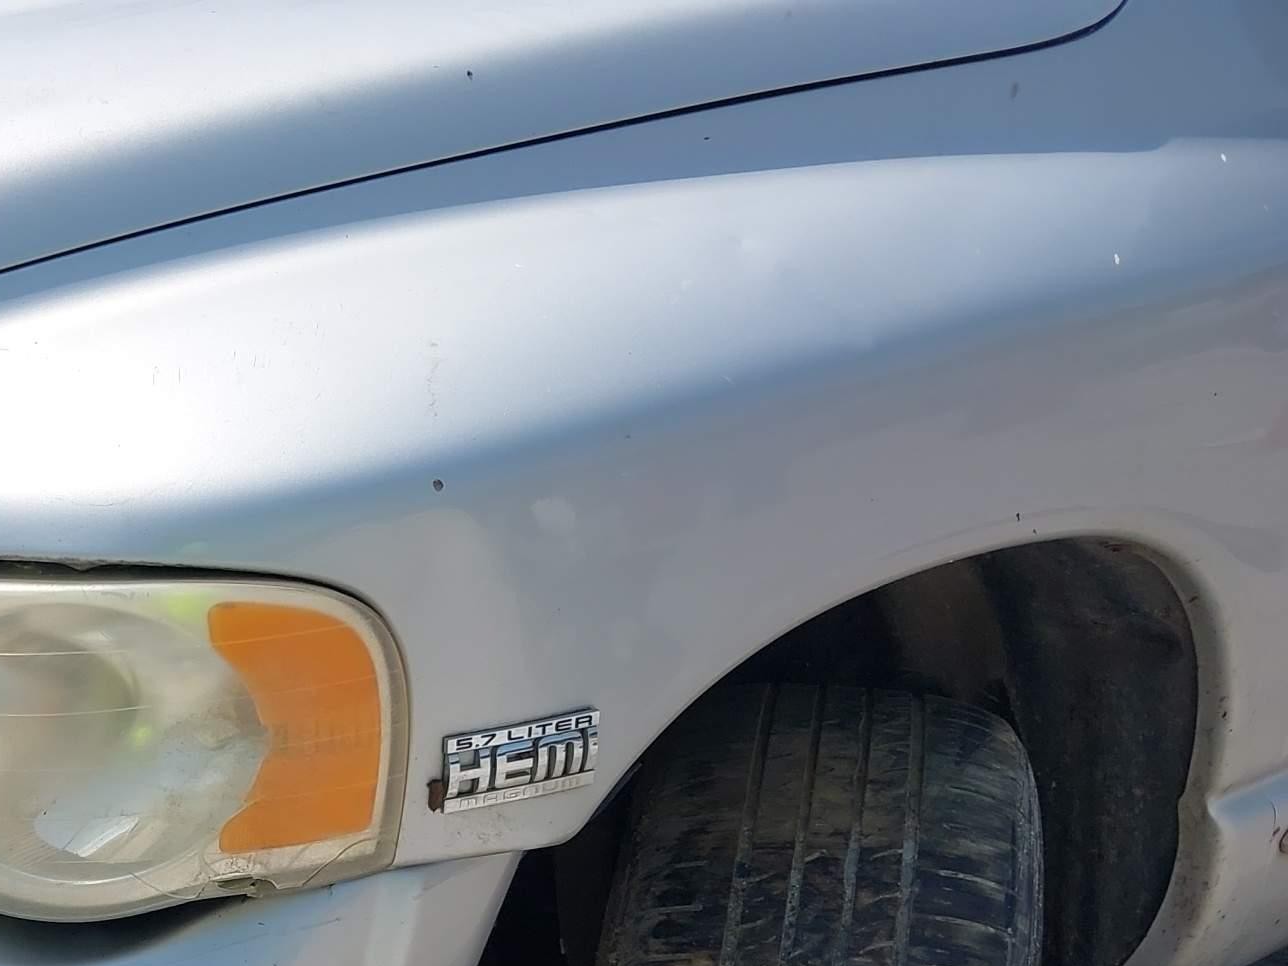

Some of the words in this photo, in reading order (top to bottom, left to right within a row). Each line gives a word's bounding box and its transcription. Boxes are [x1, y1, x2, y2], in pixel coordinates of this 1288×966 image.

[455, 733, 497, 751] 5.7
[506, 714, 593, 741] LITER
[445, 724, 599, 799] HEMI
